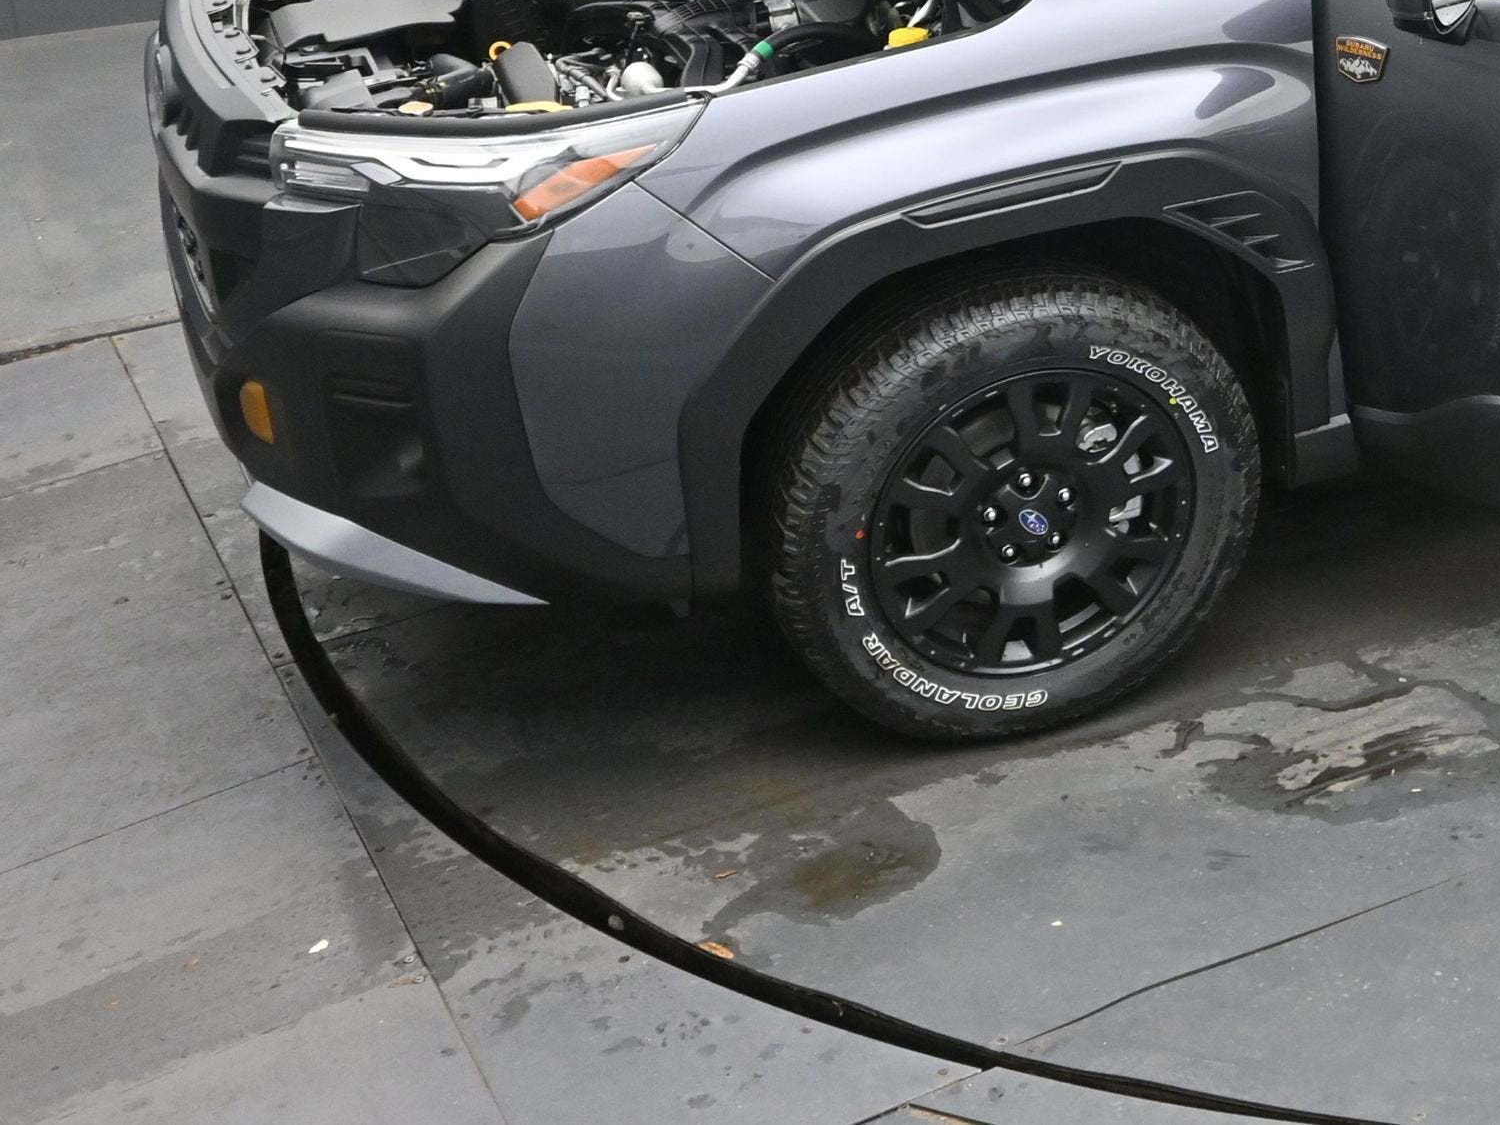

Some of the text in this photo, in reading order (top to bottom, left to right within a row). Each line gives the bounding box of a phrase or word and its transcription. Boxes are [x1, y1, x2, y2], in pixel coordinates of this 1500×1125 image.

[1089, 345, 1219, 453] YOKOHAMA
[840, 559, 1048, 711] GEOLANDAR A/T
